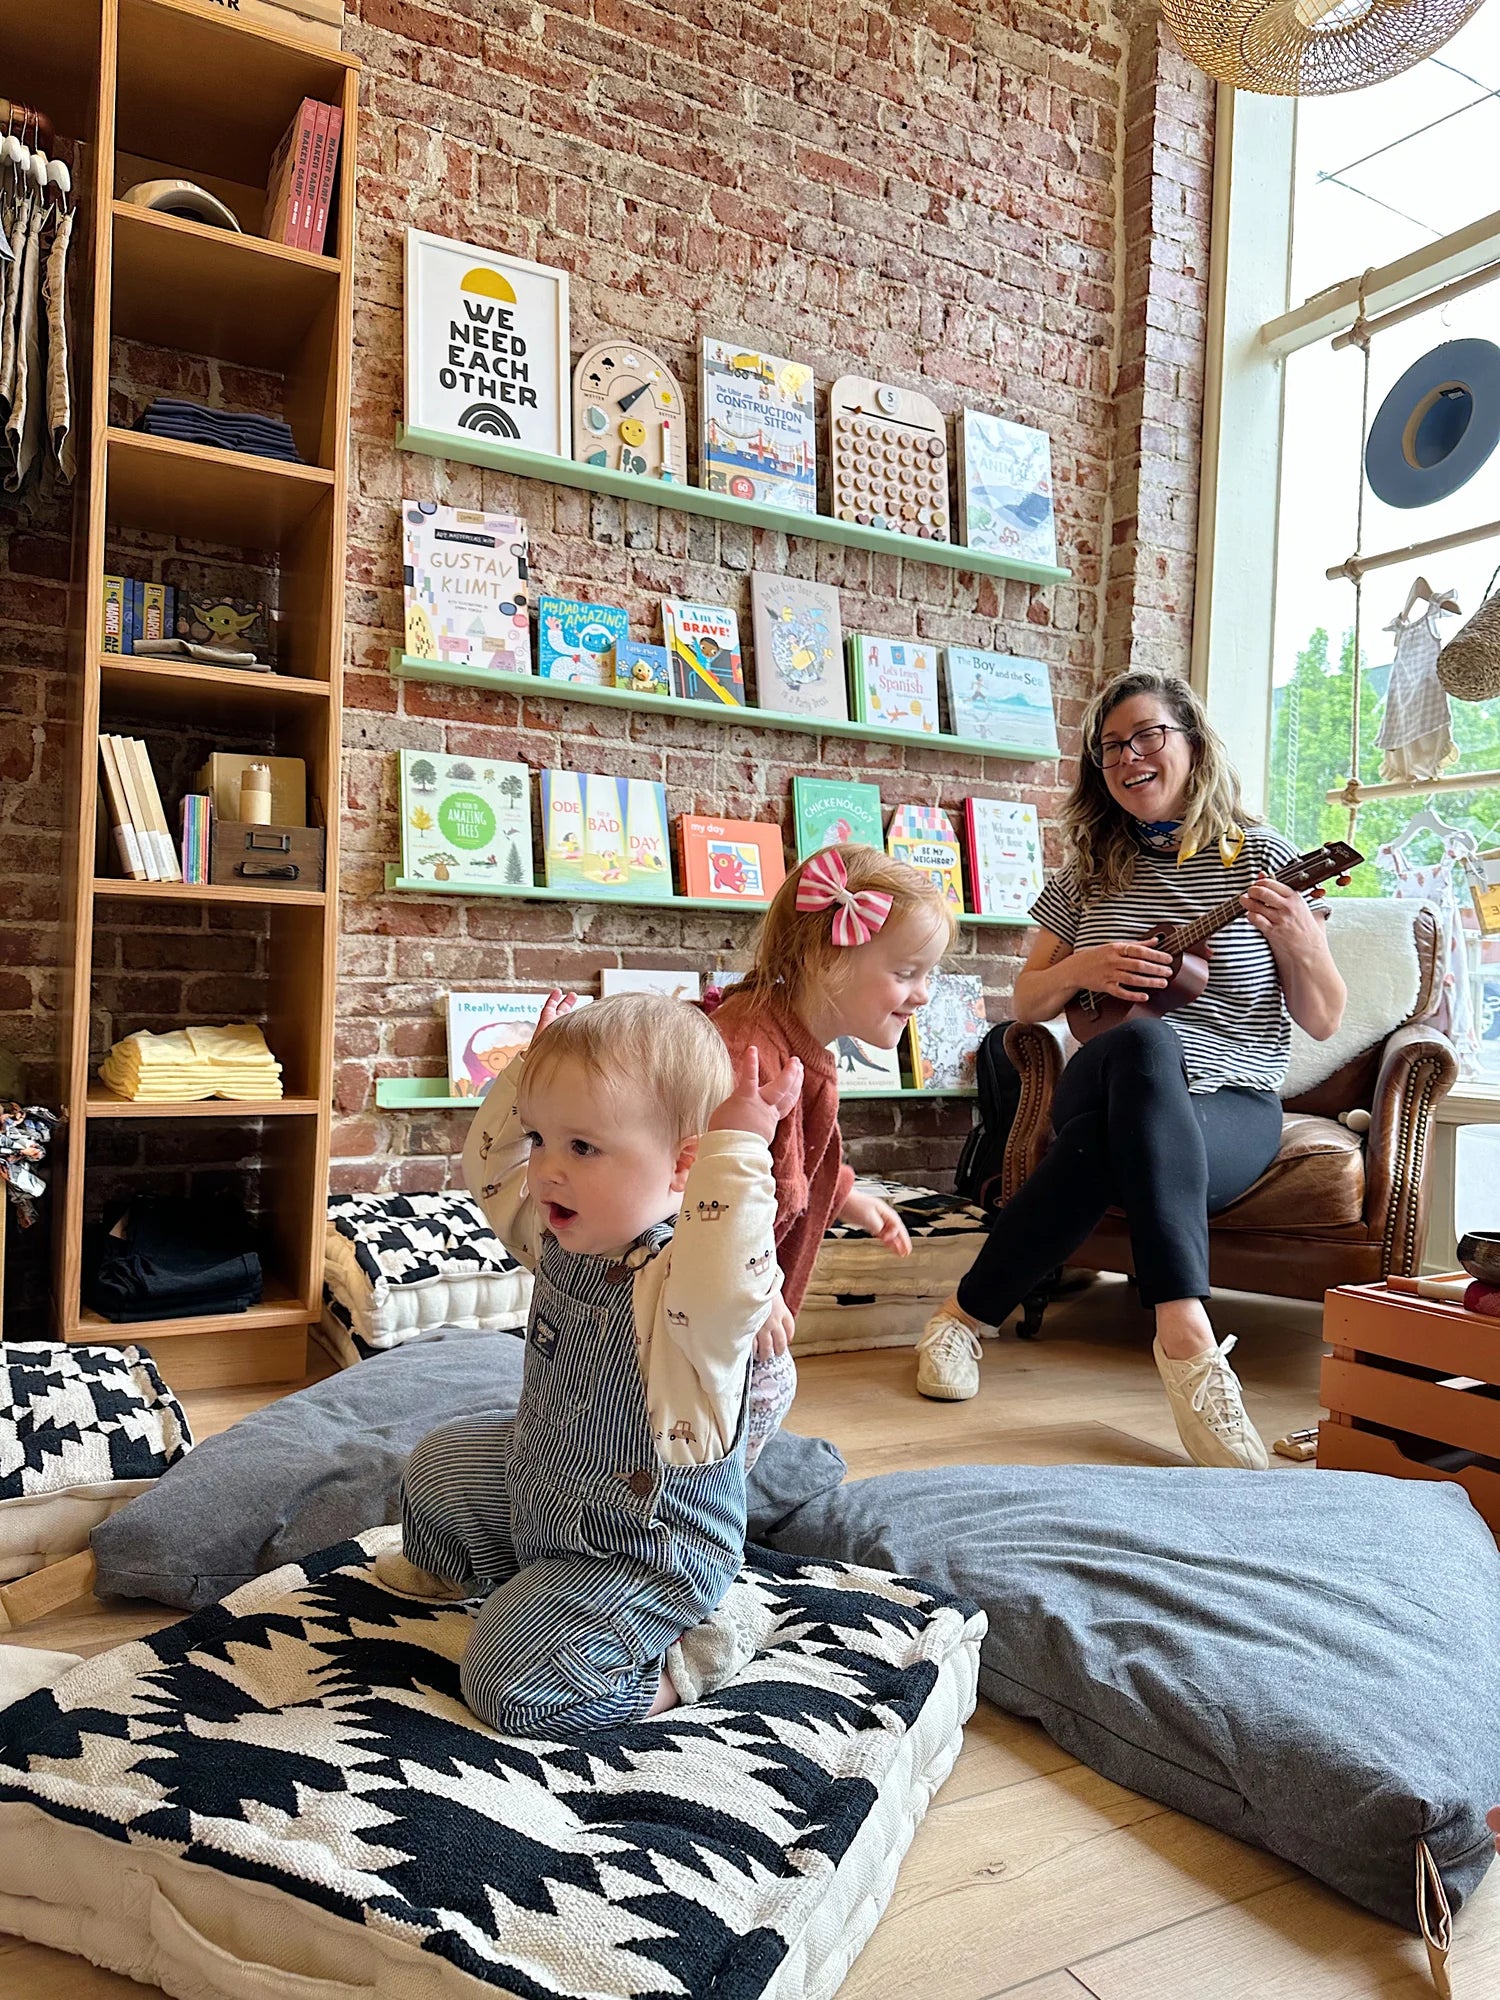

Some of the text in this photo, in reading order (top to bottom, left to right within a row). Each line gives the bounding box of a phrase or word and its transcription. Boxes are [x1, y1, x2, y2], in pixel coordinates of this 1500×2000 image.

[299, 130, 311, 165] MAKER
[312, 134, 323, 169] MAKER
[325, 138, 336, 173] MAKER
[295, 168, 305, 197] CAMP
[308, 172, 318, 200] CAMP
[320, 175, 331, 204] CAMP
[463, 299, 514, 332] WE
[450, 320, 527, 357] NEED
[448, 344, 529, 383] EACH
[439, 367, 538, 409] OTHER
[716, 384, 727, 393] The
[887, 392, 894, 402] 5
[716, 393, 802, 424] CONSTRUCTION
[764, 416, 786, 431] SITE
[737, 482, 748, 492] 60
[430, 552, 512, 578] GUSTAV
[441, 576, 501, 599] KLIMT
[105, 602, 119, 633] MARVEL
[559, 601, 579, 615] DAD
[679, 609, 731, 625] I Am So
[147, 608, 160, 640] MARVEL
[682, 622, 730, 638] BRAVE!
[957, 656, 1044, 687] The Boy and the Sea
[879, 675, 923, 693] Spanish
[448, 808, 487, 825] AMAZING
[552, 801, 580, 813] ODE
[804, 797, 874, 823] CHICKENOLOGY
[456, 822, 480, 838] TREES
[587, 817, 620, 832] BAD
[690, 823, 725, 836] my day
[629, 835, 660, 850] DAY
[933, 848, 943, 856] MY
[913, 856, 954, 865] NEIGHBOR?
[458, 1003, 538, 1014] I Really Want to
